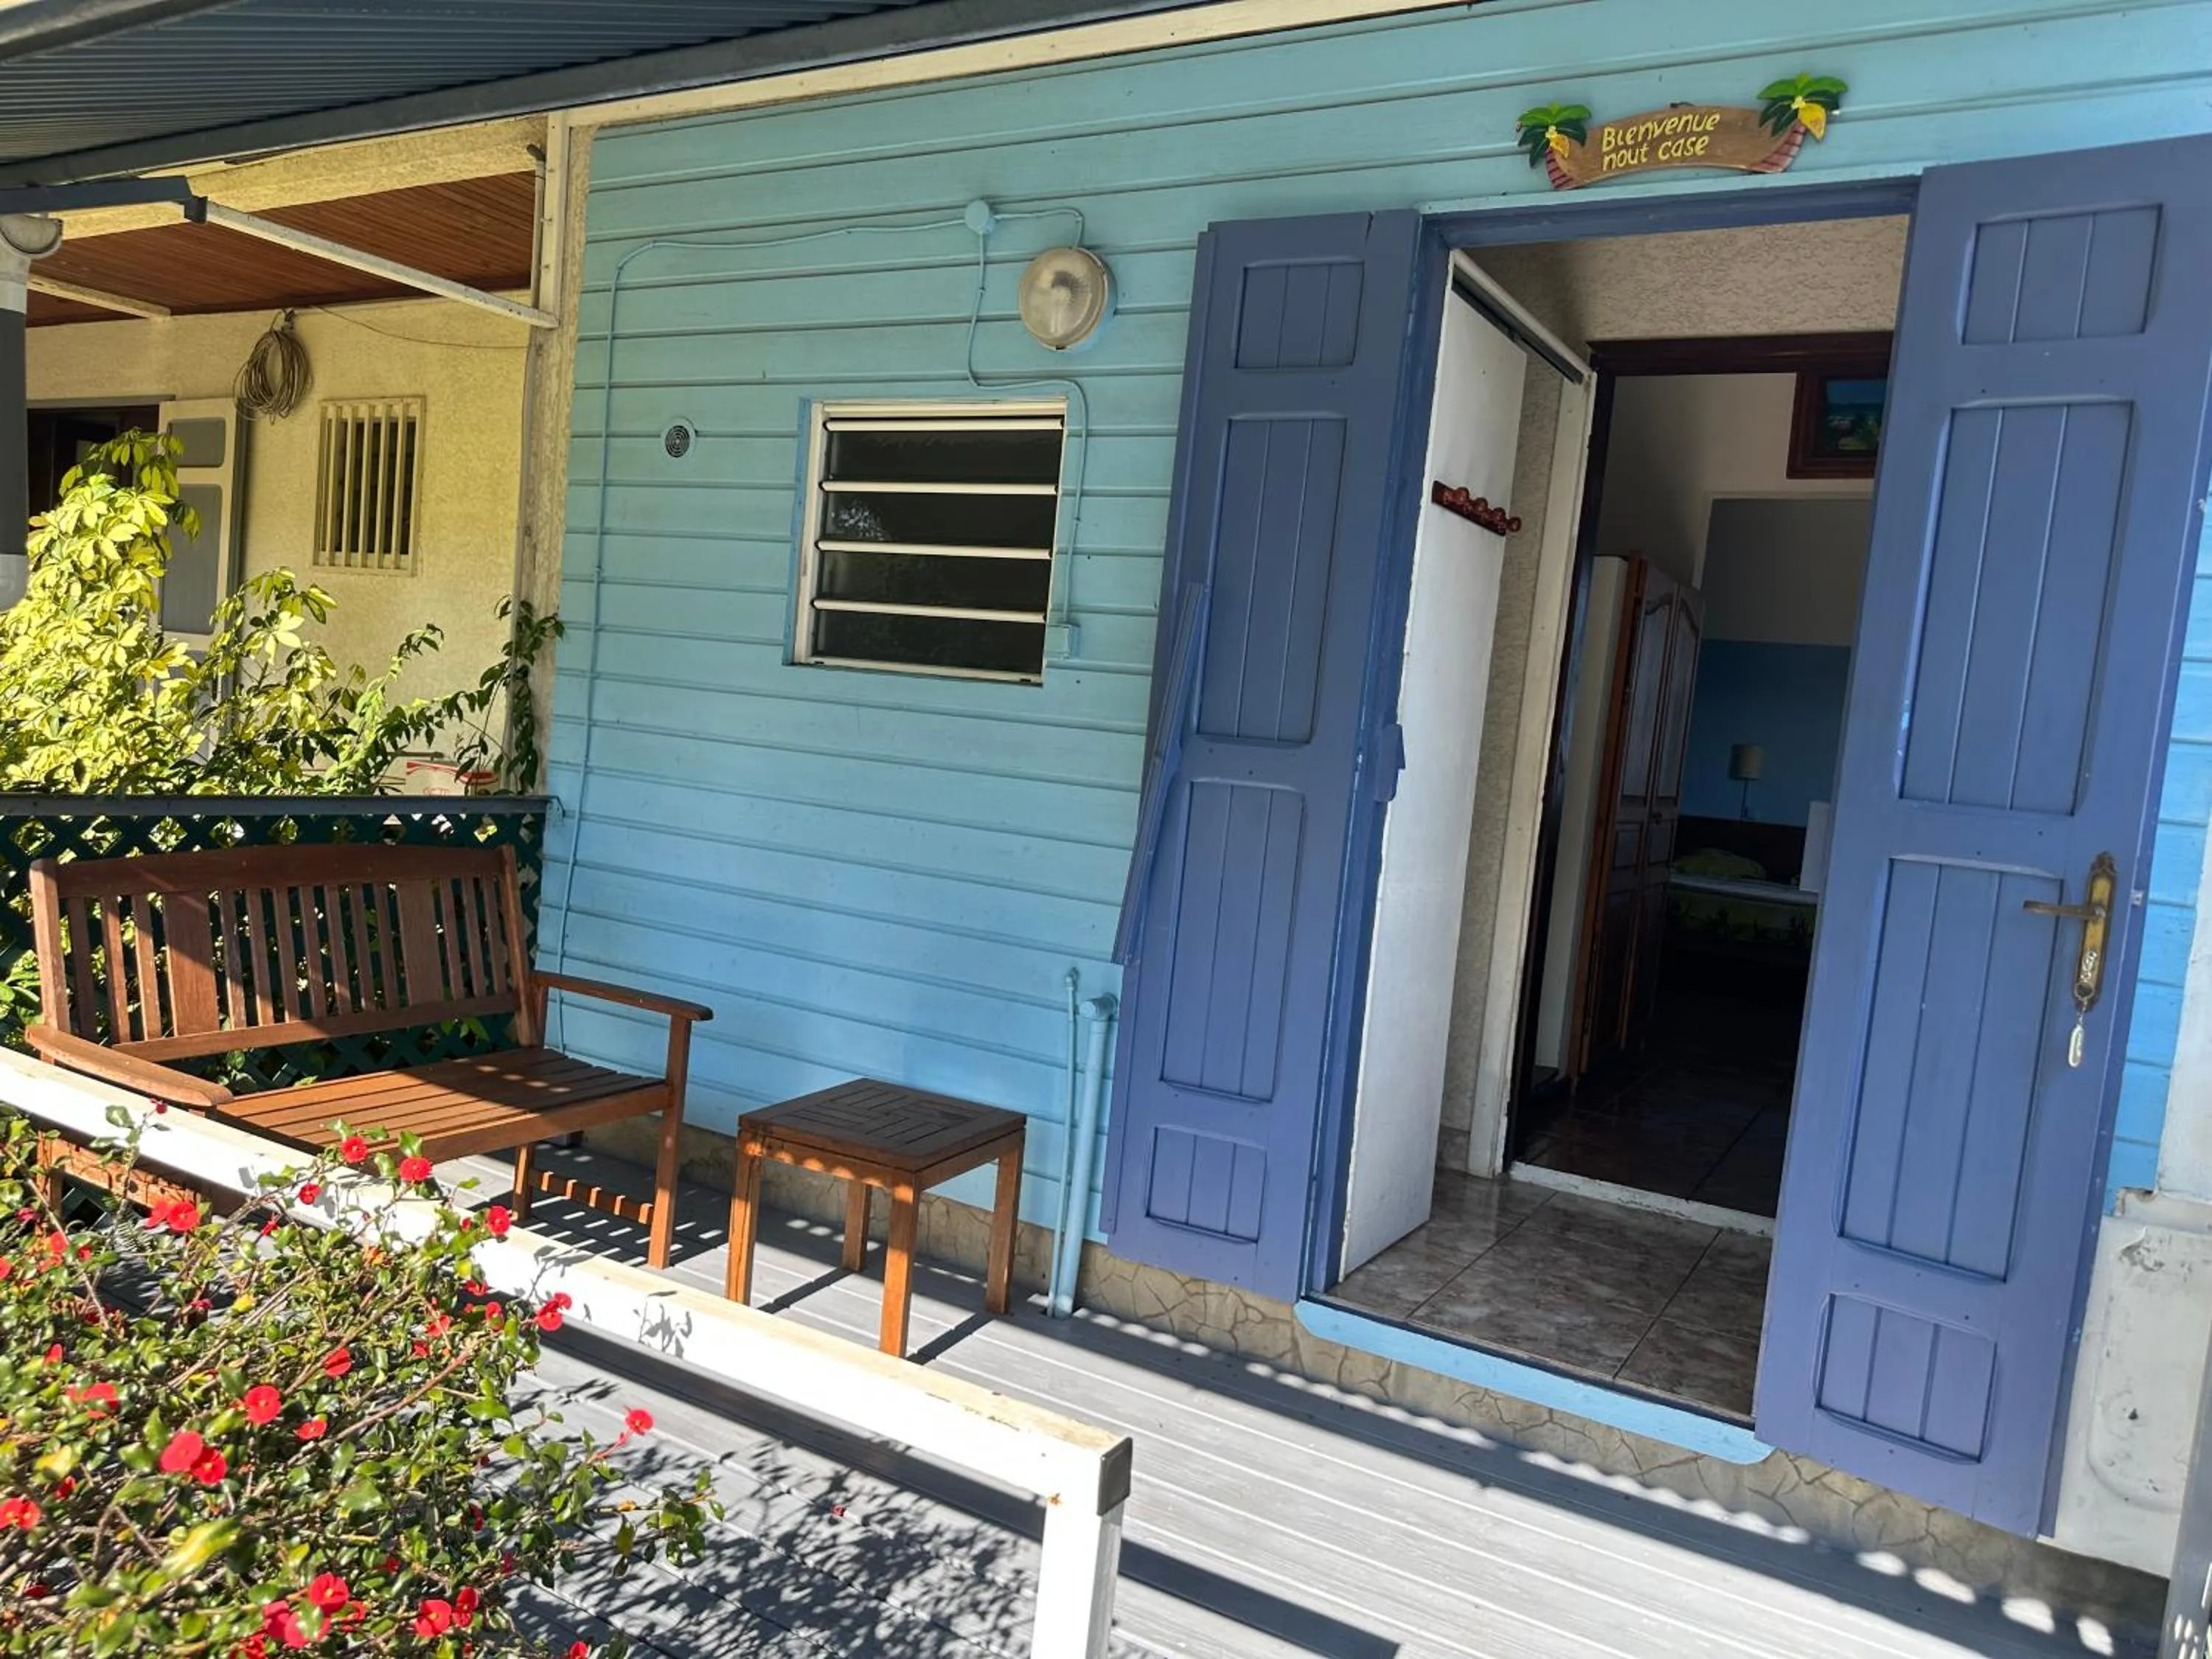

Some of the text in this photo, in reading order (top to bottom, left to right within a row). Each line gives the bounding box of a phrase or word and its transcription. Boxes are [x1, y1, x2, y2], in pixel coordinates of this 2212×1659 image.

[1602, 112, 1721, 152] Bienvenue
[1602, 135, 1710, 172] nout case
